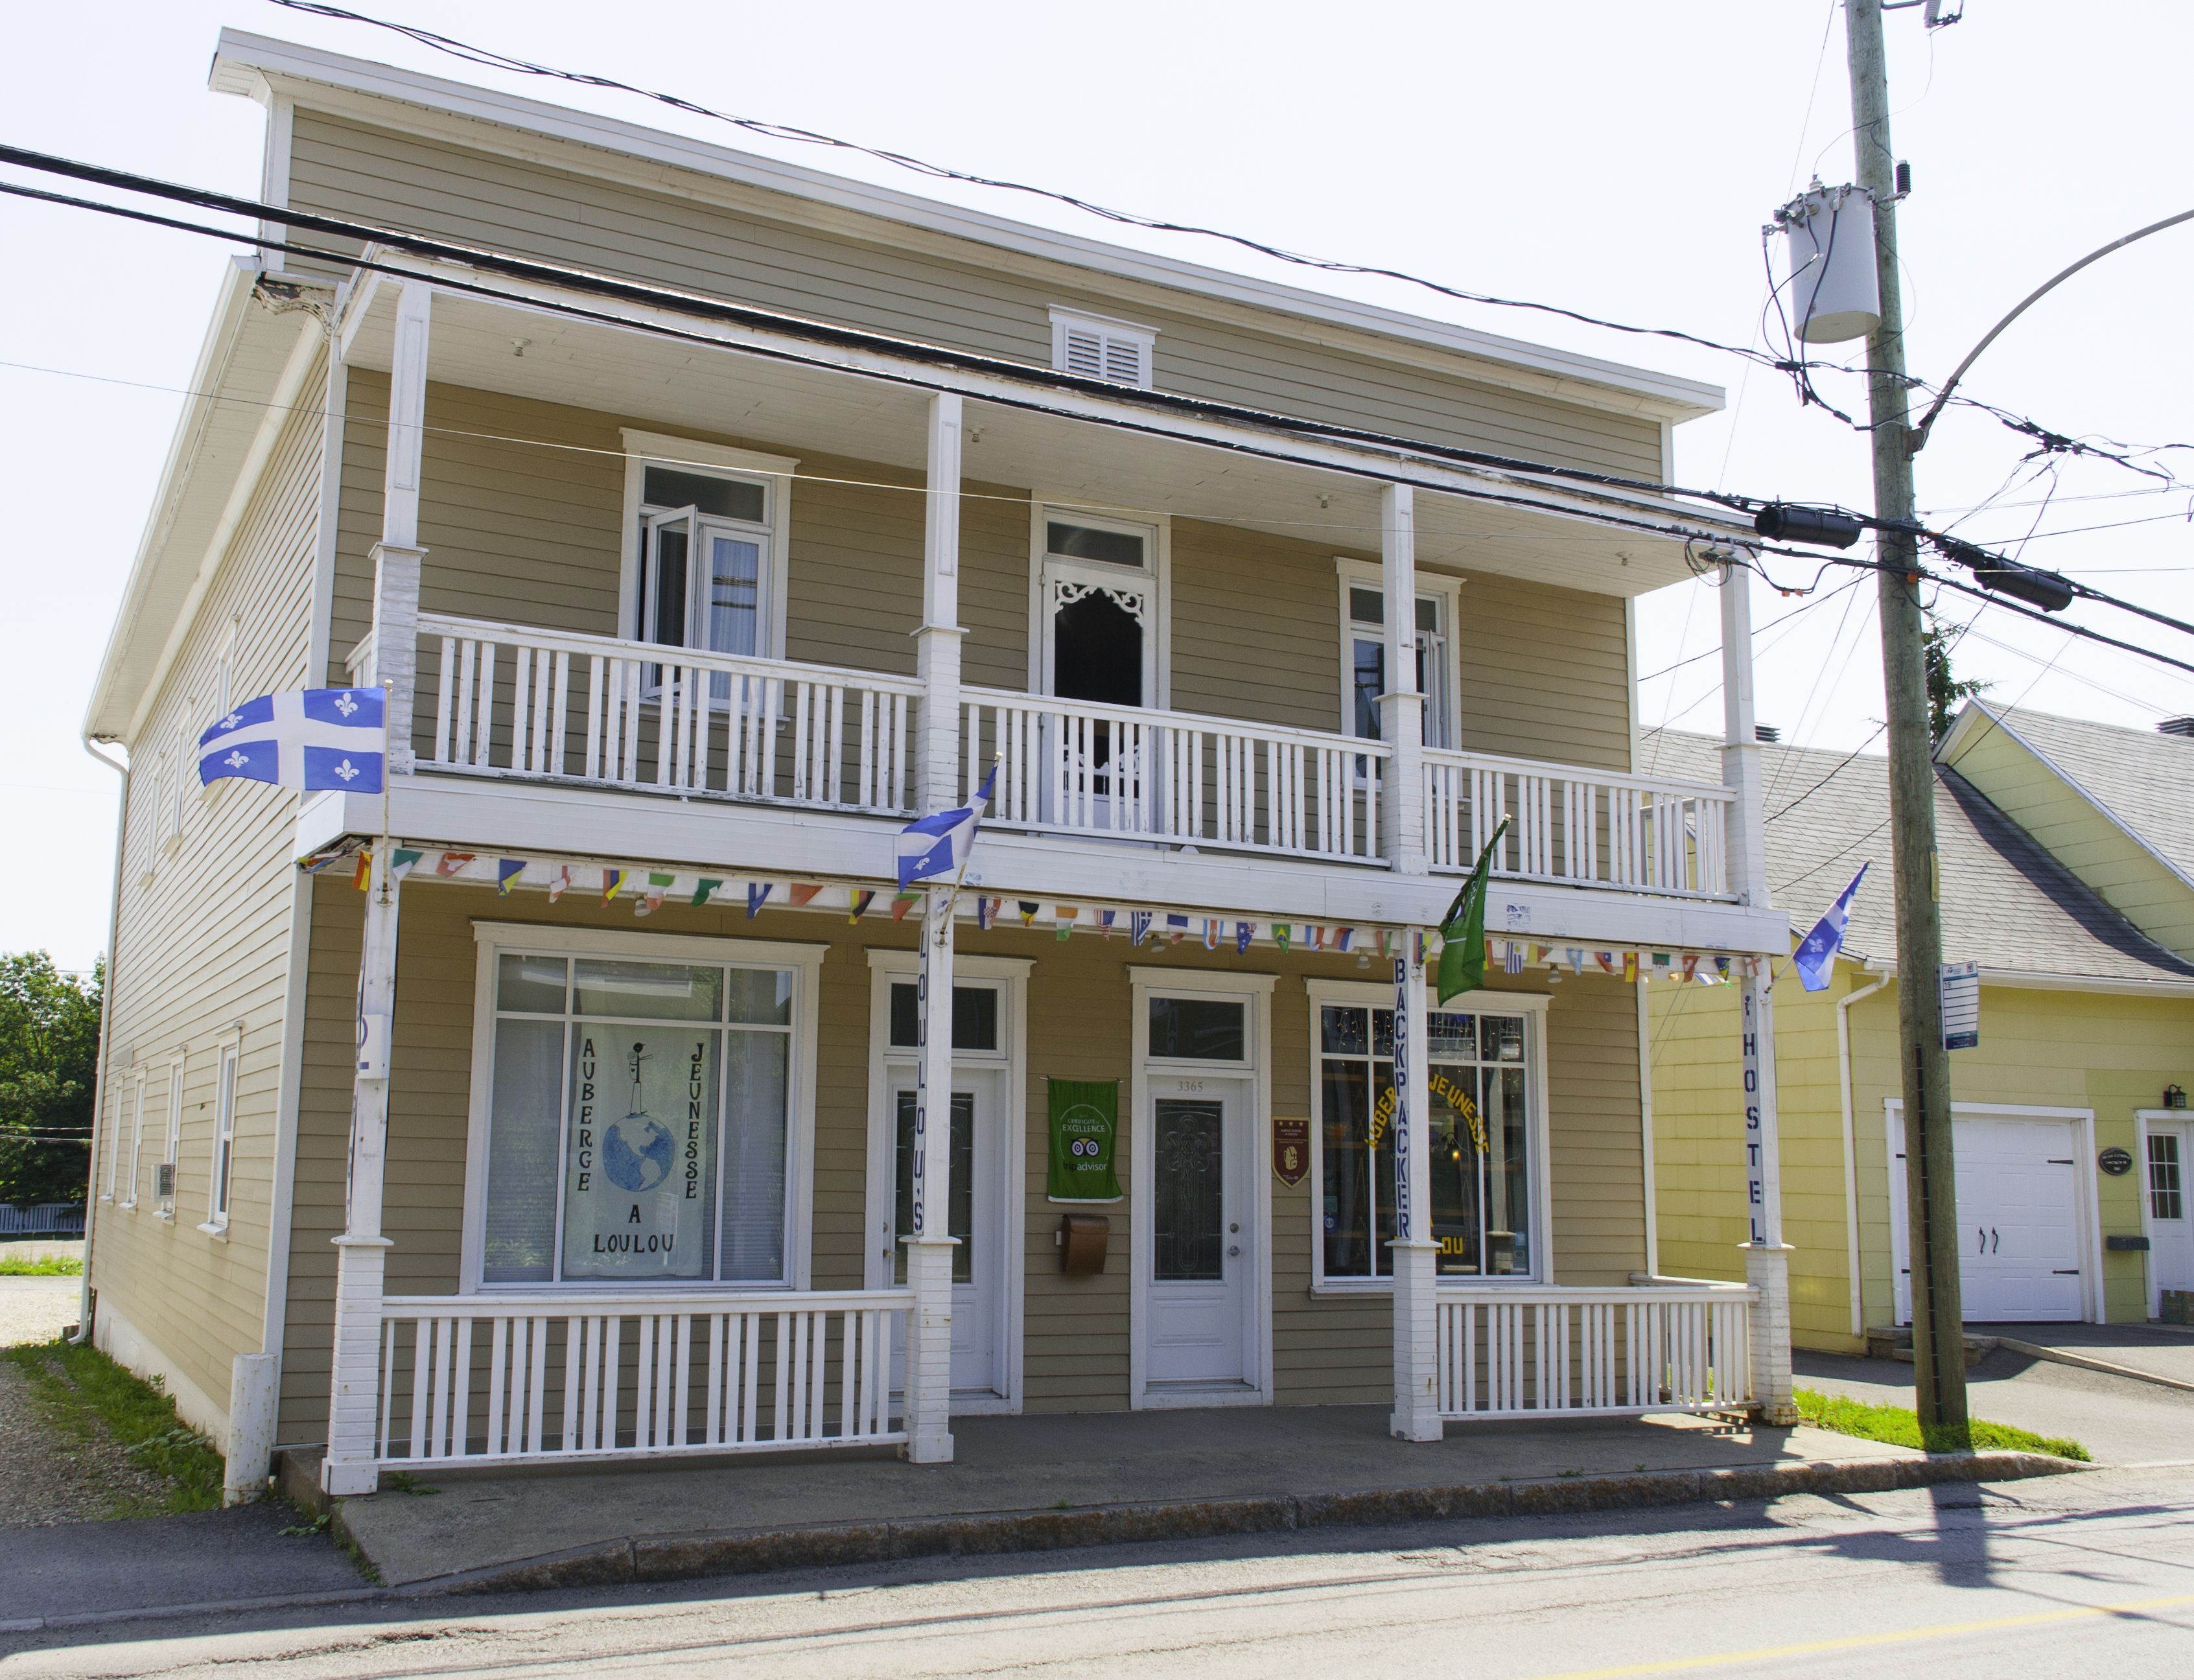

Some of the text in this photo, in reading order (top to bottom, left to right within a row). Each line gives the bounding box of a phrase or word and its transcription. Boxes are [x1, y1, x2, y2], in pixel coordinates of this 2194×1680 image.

[577, 1038, 596, 1192] AUBERGE
[684, 1042, 705, 1200] JEUNESSE
[915, 931, 926, 1231] LOULOU'S
[1177, 1080, 1203, 1092] 3365
[1364, 1073, 1490, 1155] AUBER JEUNESSE
[1394, 957, 1410, 1239] BACKPACKER
[1062, 1124, 1106, 1132] EXCELLENCE
[1063, 1161, 1108, 1172] tripadvisor
[1743, 1033, 1762, 1241] HOSTEL
[594, 1233, 674, 1253] LOULOU
[628, 1204, 642, 1224] A
